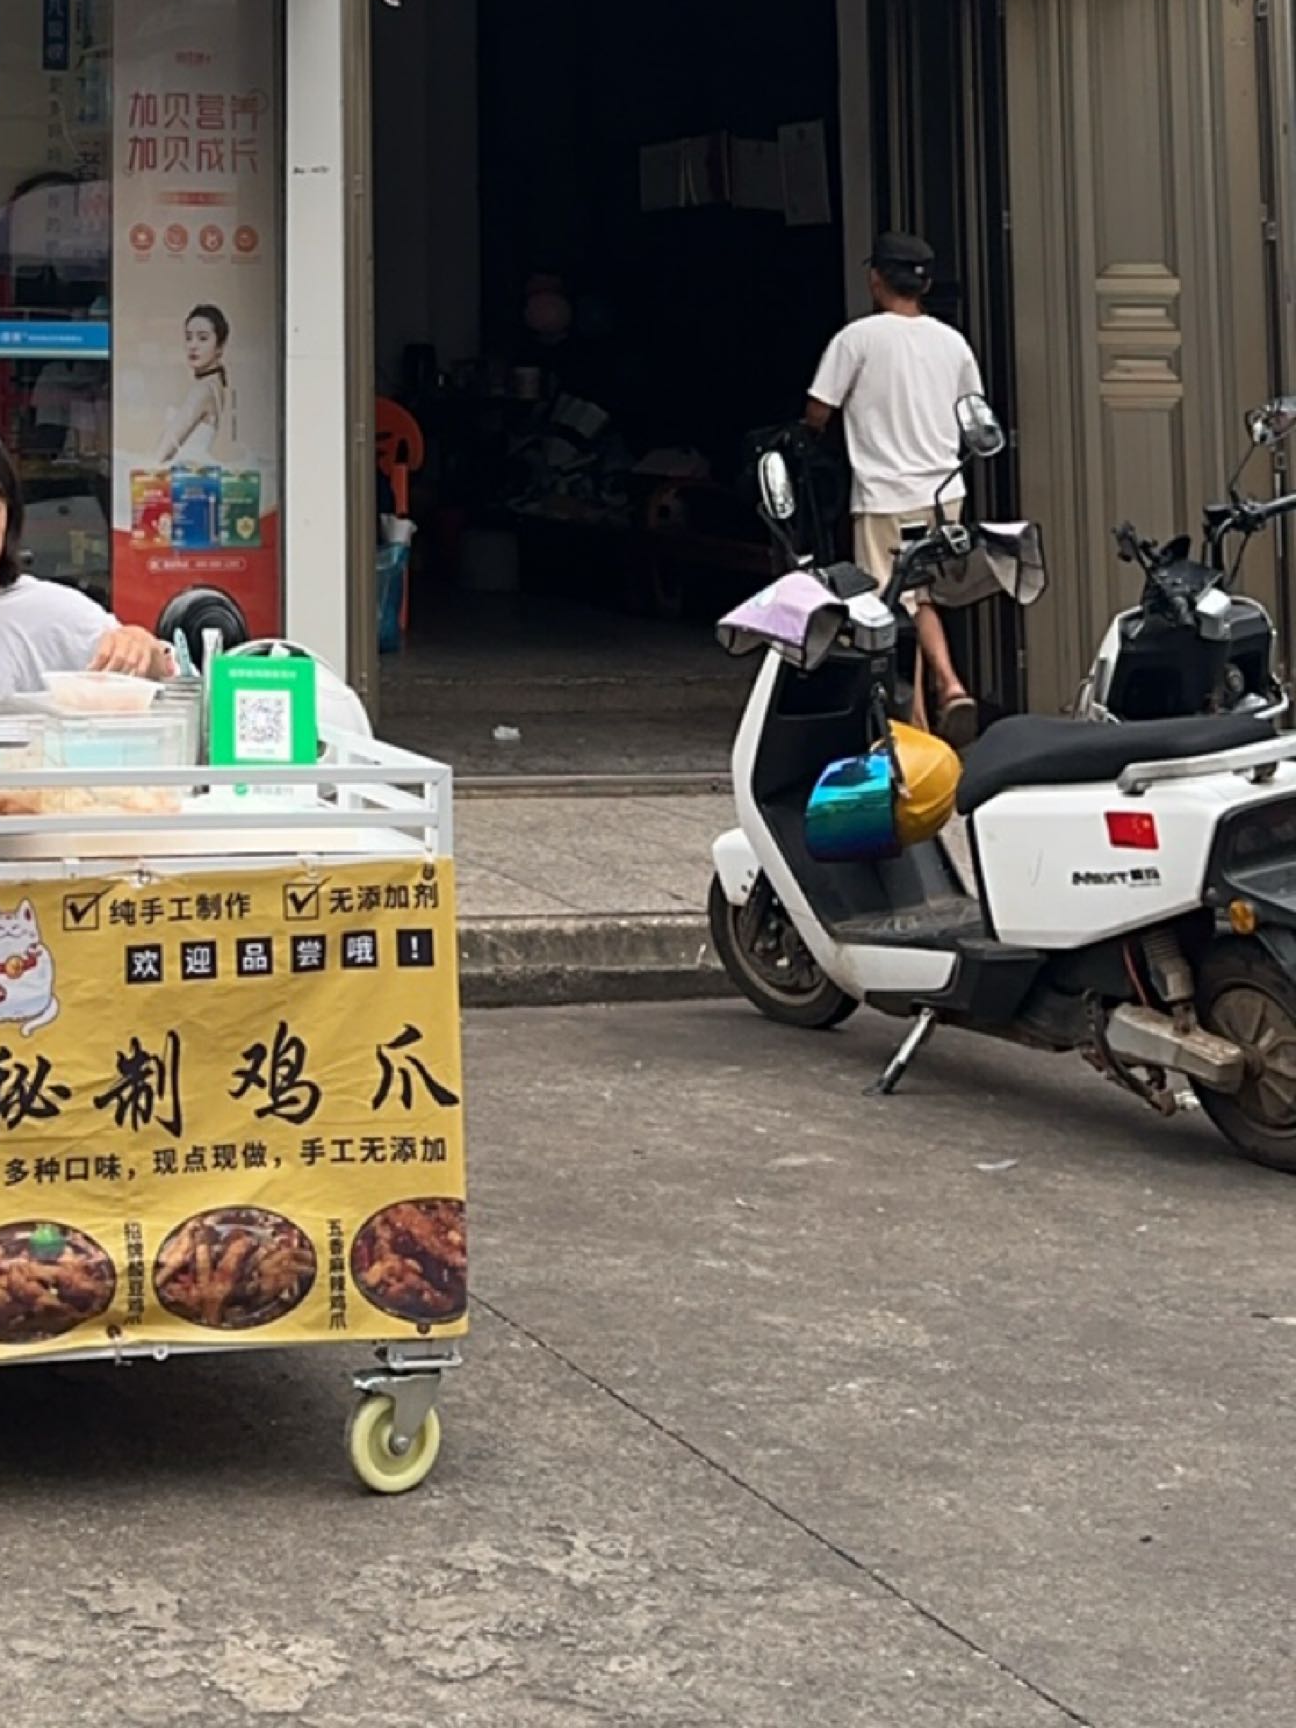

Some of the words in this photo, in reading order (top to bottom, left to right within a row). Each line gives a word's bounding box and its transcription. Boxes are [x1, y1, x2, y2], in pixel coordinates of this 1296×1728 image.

[109, 892, 251, 926] 纯手工制作
[329, 883, 439, 915] 无添加剂
